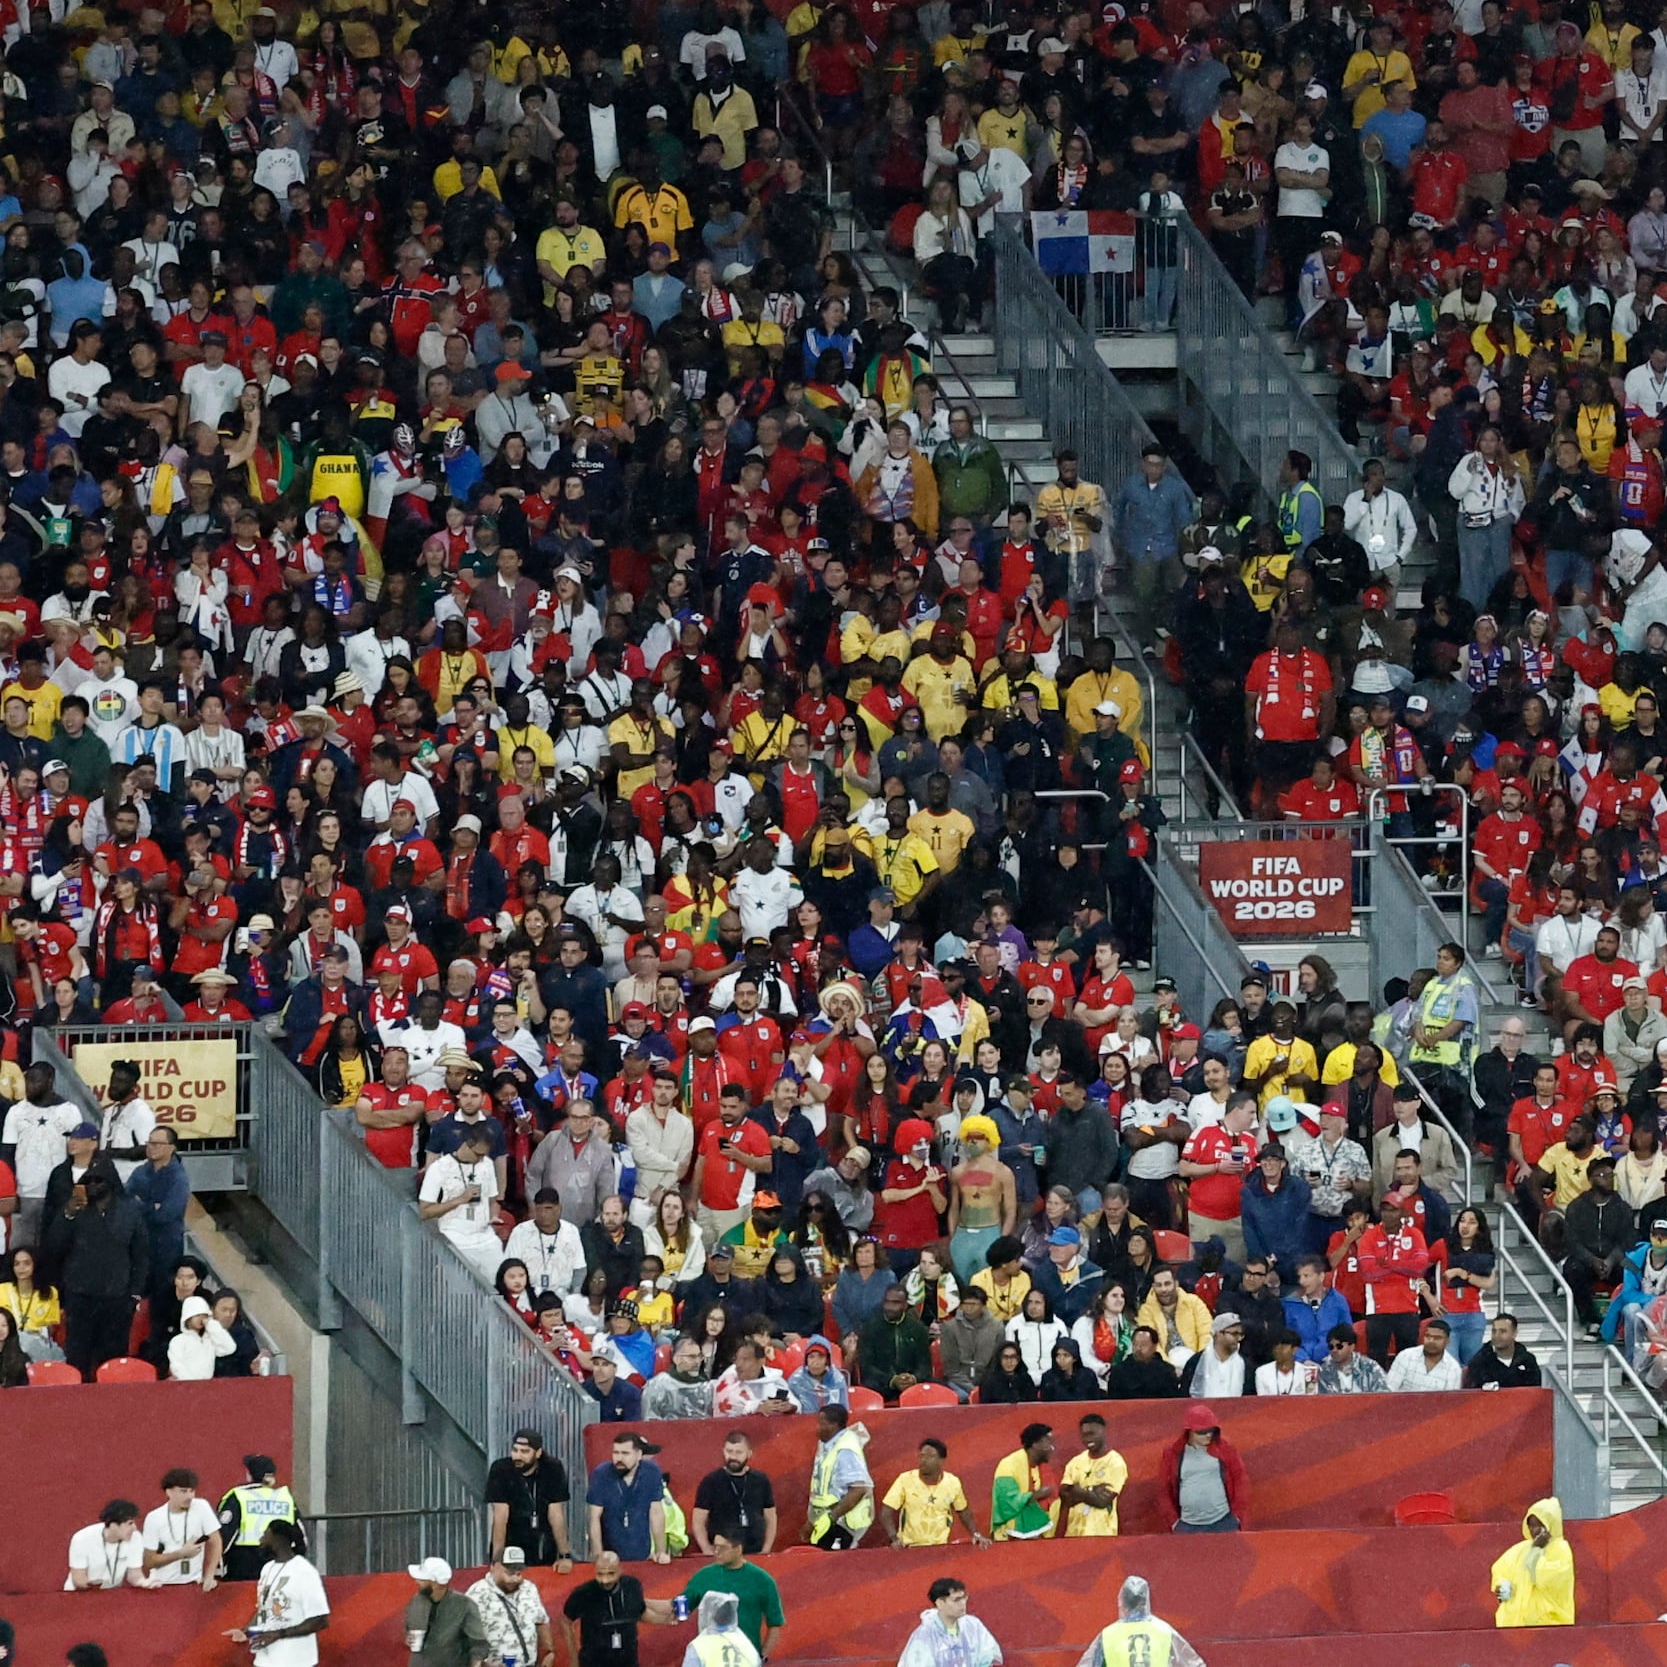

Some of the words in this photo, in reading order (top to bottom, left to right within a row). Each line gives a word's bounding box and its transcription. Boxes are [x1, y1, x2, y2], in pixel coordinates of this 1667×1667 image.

[320, 462, 360, 474] GHANA
[1252, 857, 1302, 875] FIFA
[1210, 879, 1294, 898] WORLD
[1297, 877, 1344, 897] CUP
[1235, 900, 1316, 920] 2026
[92, 1082, 173, 1102] WLD
[178, 1080, 227, 1098] CUP
[155, 1105, 197, 1124] 26
[1347, 1256, 1358, 1273] 2
[247, 1501, 290, 1514] POLICE
